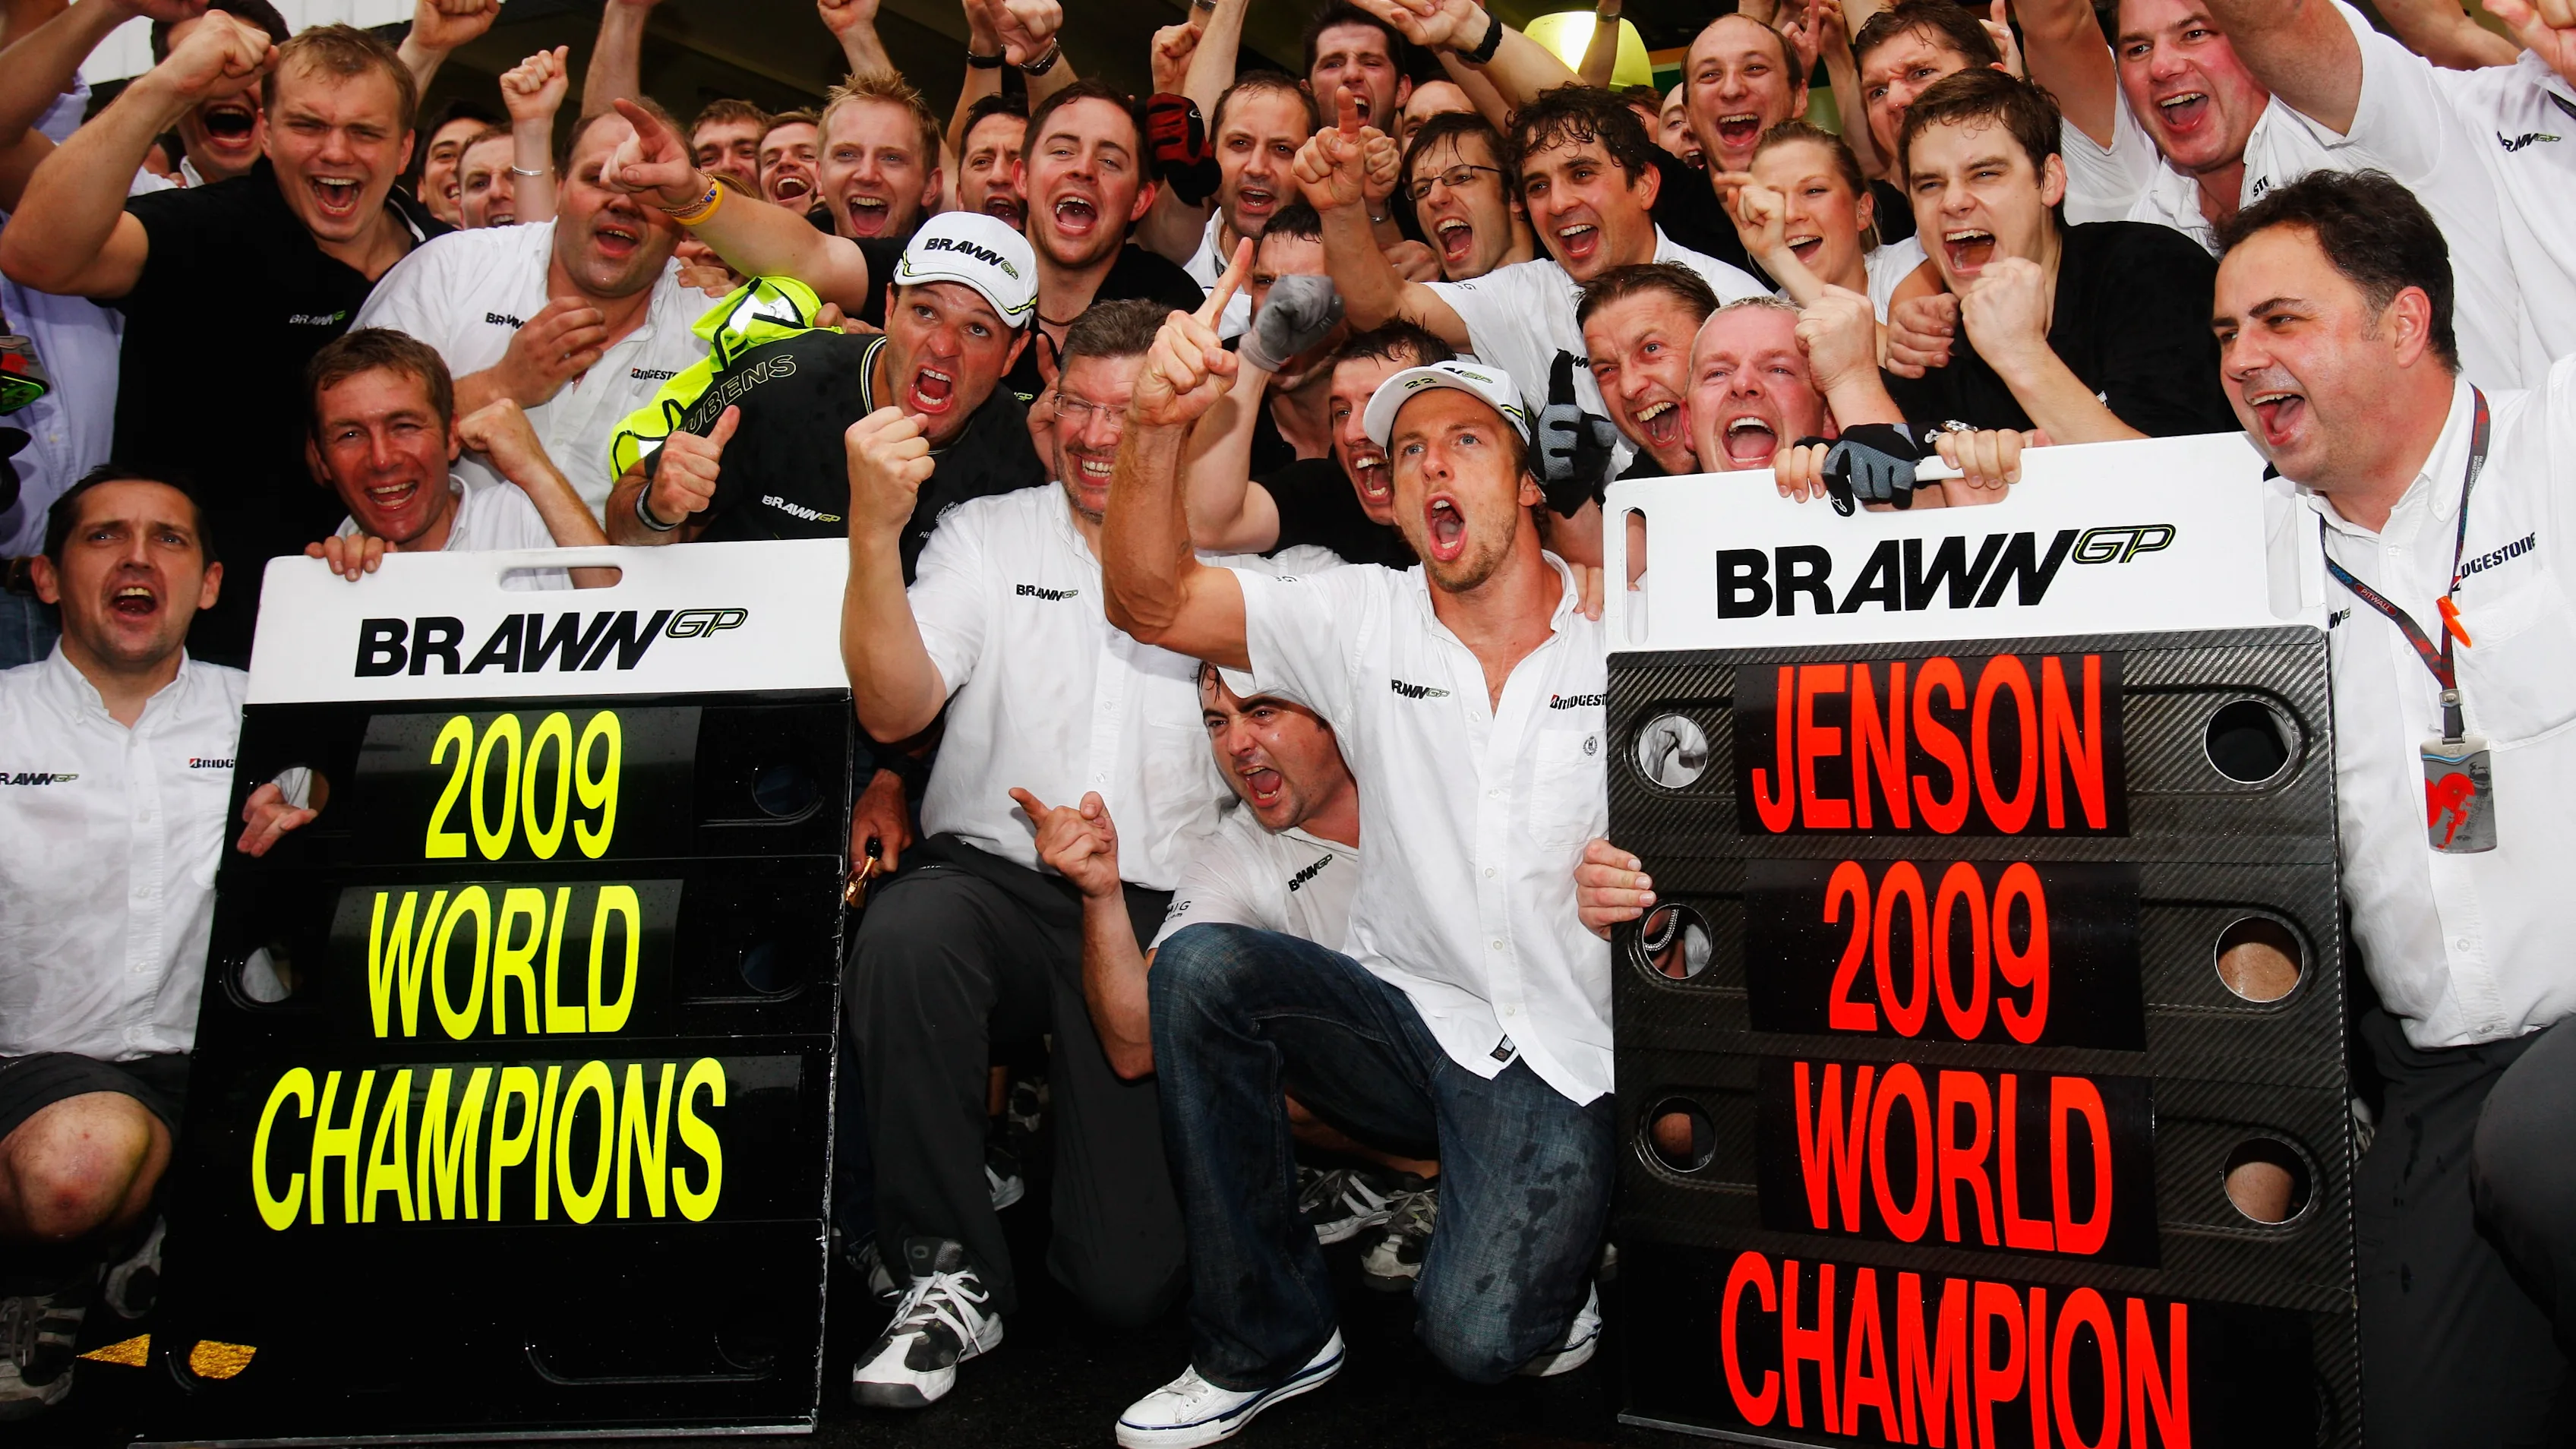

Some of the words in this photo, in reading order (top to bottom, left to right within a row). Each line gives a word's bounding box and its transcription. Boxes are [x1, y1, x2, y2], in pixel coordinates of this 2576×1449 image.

[677, 354, 797, 435] UBENS
[2361, 588, 2390, 612] PITWALL
[1550, 694, 1607, 709] BRIDGEST
[1751, 653, 2107, 835] JENSON
[425, 710, 622, 861] 2009
[368, 885, 640, 1040] WORLD
[1823, 860, 2050, 1044] 2009
[251, 1056, 727, 1231] CHAMPIONS
[1794, 1061, 2113, 1255] WORLD
[1721, 1251, 2192, 1449] CHAMPION
